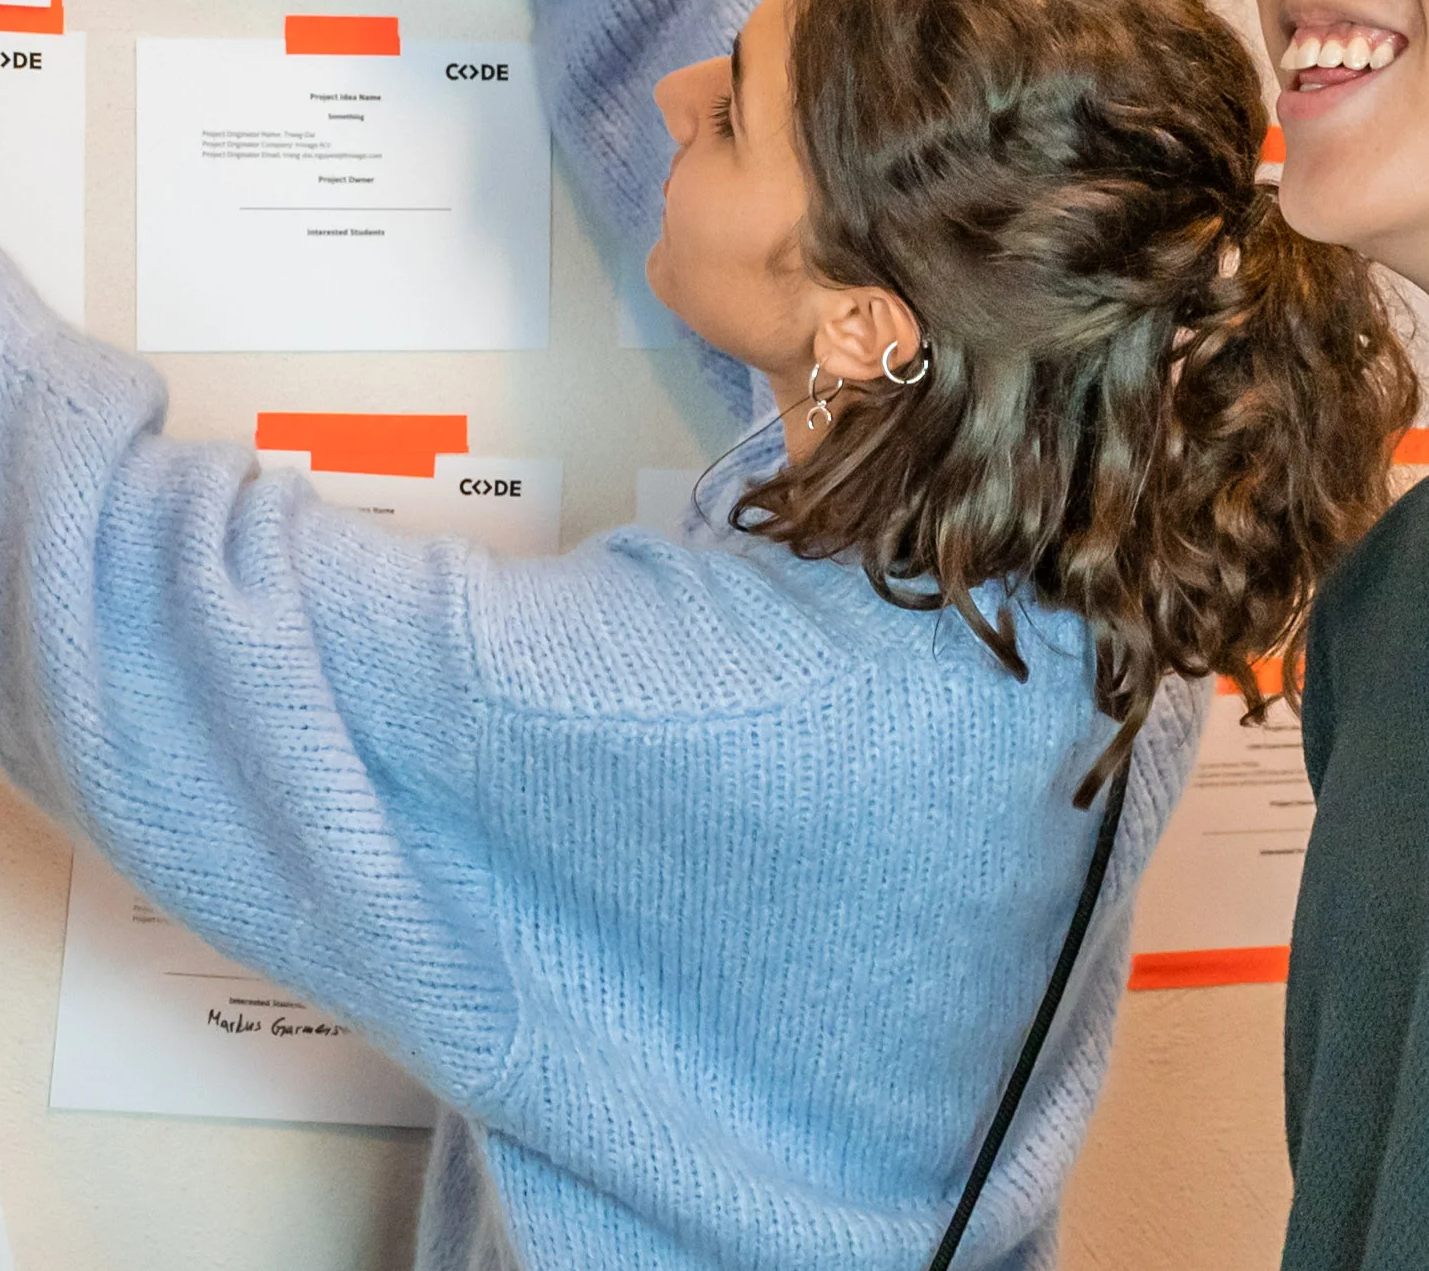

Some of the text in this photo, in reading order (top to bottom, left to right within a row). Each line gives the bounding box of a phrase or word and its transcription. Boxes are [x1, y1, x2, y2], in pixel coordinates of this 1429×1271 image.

[310, 92, 382, 103] Project Idea Name
[318, 174, 375, 185] Project Owner
[307, 227, 386, 236] Interested Students
[228, 996, 270, 1007] Interested
